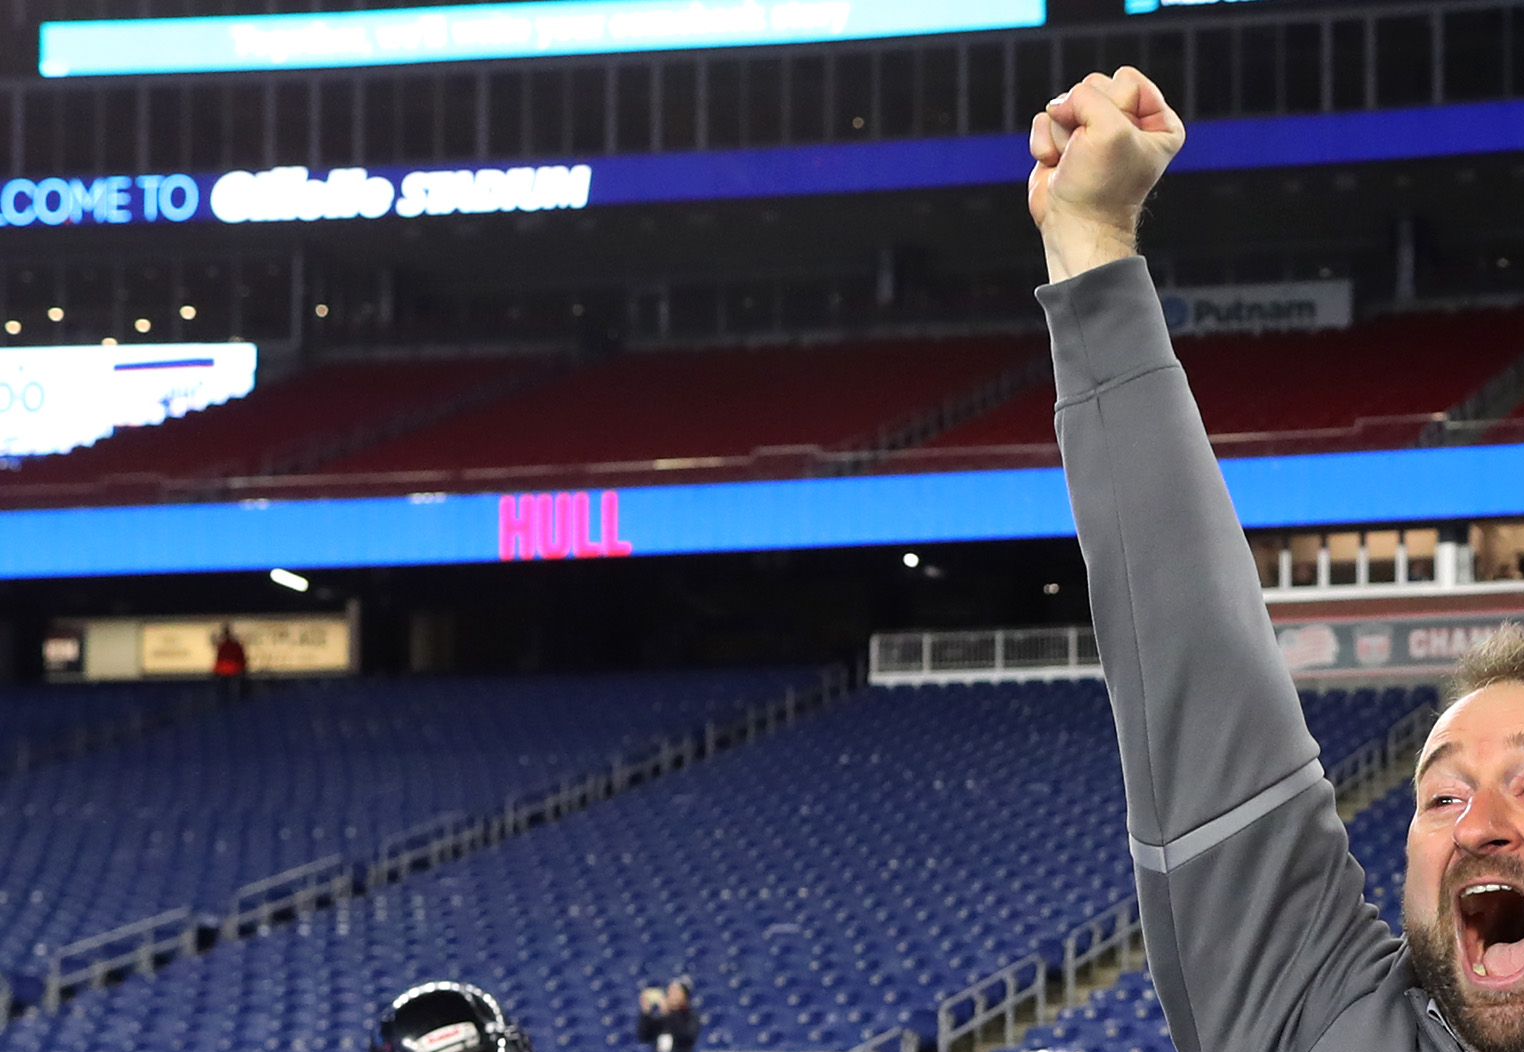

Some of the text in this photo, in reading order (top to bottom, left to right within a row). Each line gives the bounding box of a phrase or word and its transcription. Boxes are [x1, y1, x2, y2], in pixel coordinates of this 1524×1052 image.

[0, 176, 132, 226] COME
[136, 173, 200, 222] TO
[396, 164, 592, 218] STADIUM
[500, 491, 631, 561] HULL
